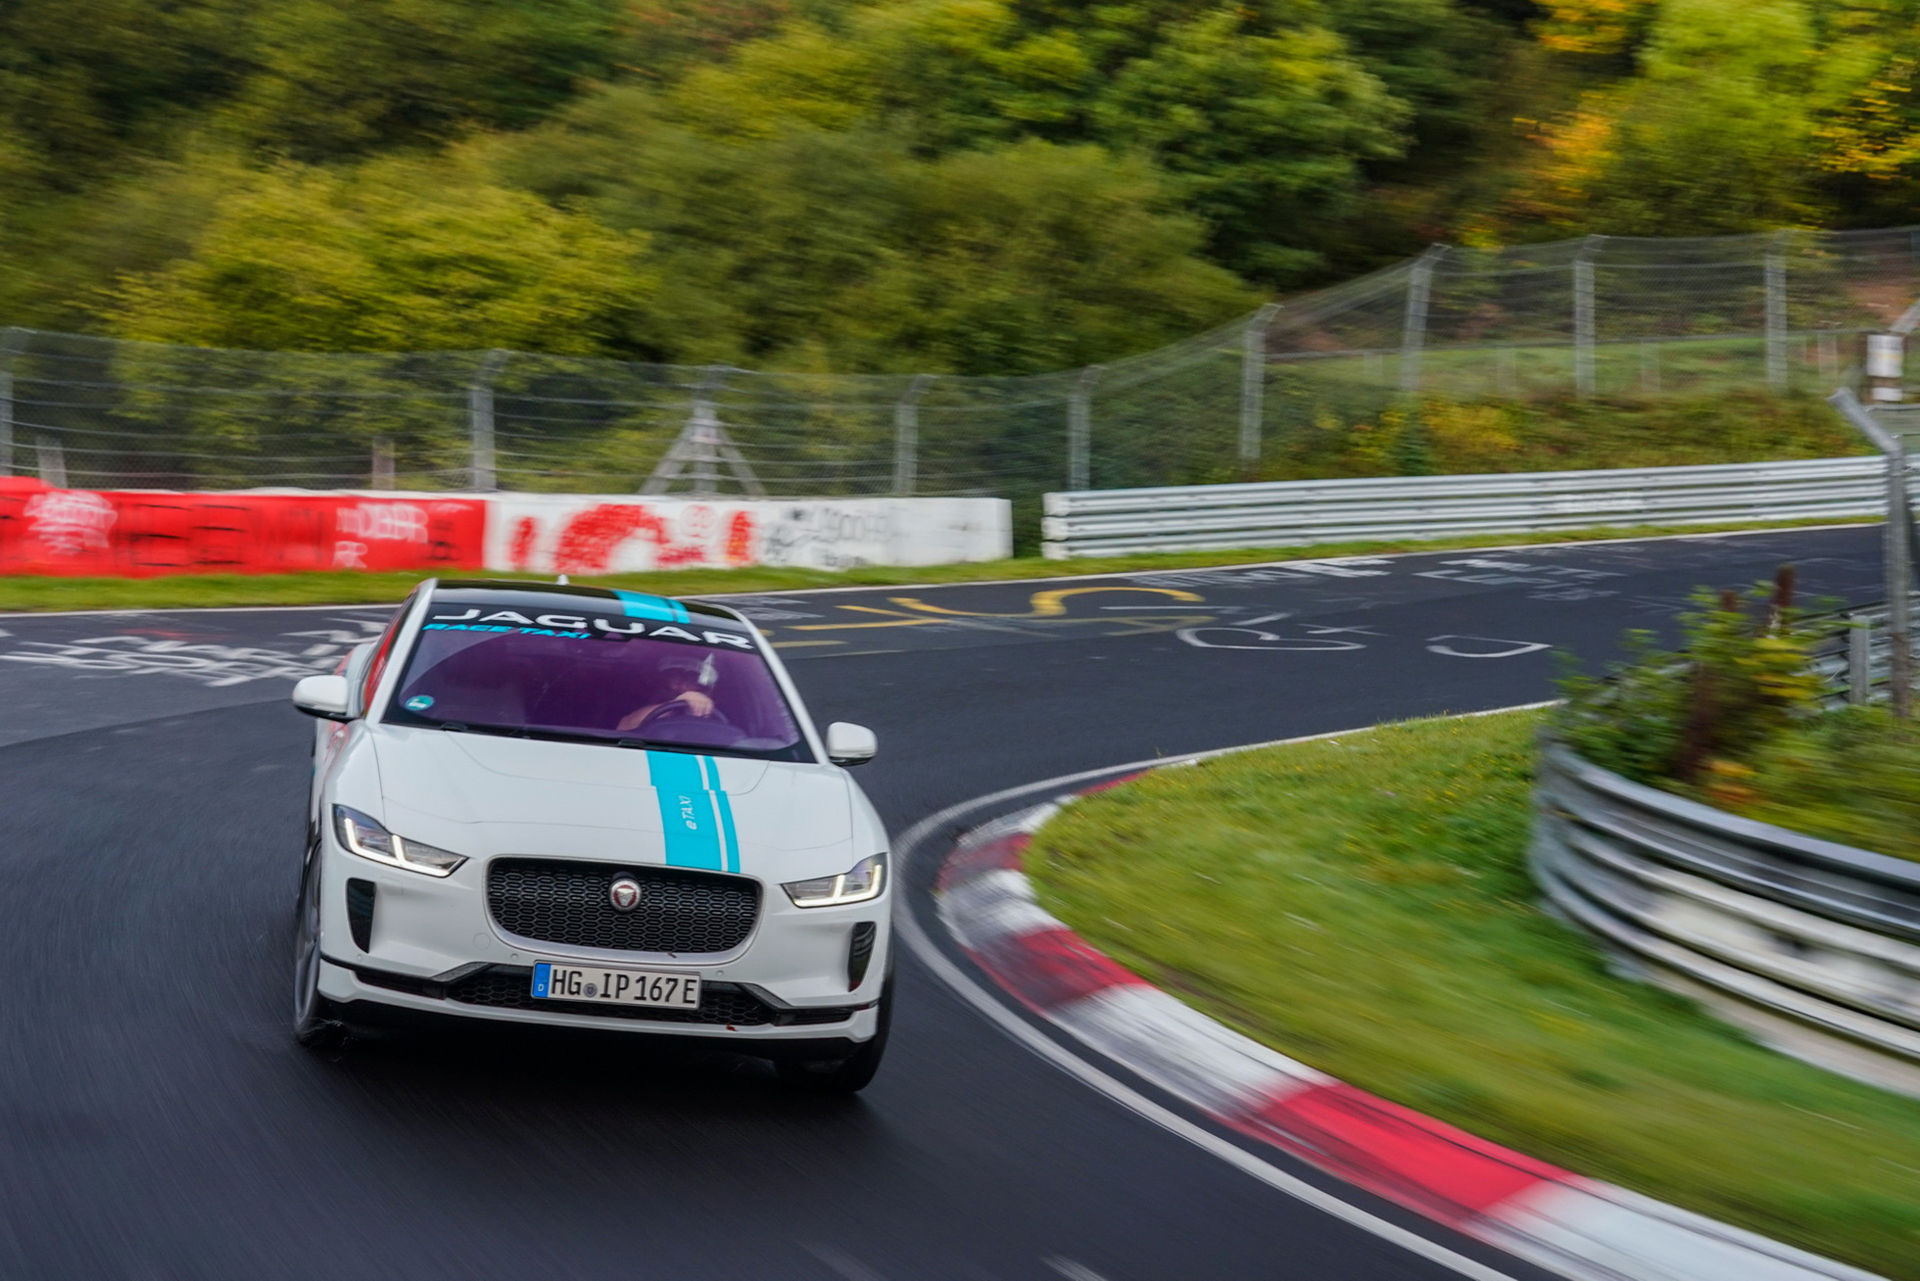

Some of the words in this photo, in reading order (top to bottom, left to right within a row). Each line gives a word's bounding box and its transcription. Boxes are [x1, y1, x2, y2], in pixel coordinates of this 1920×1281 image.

[422, 622, 512, 633] RACE
[518, 627, 592, 640] TAXI
[432, 608, 754, 649] JAGUAR
[551, 969, 583, 996] HG
